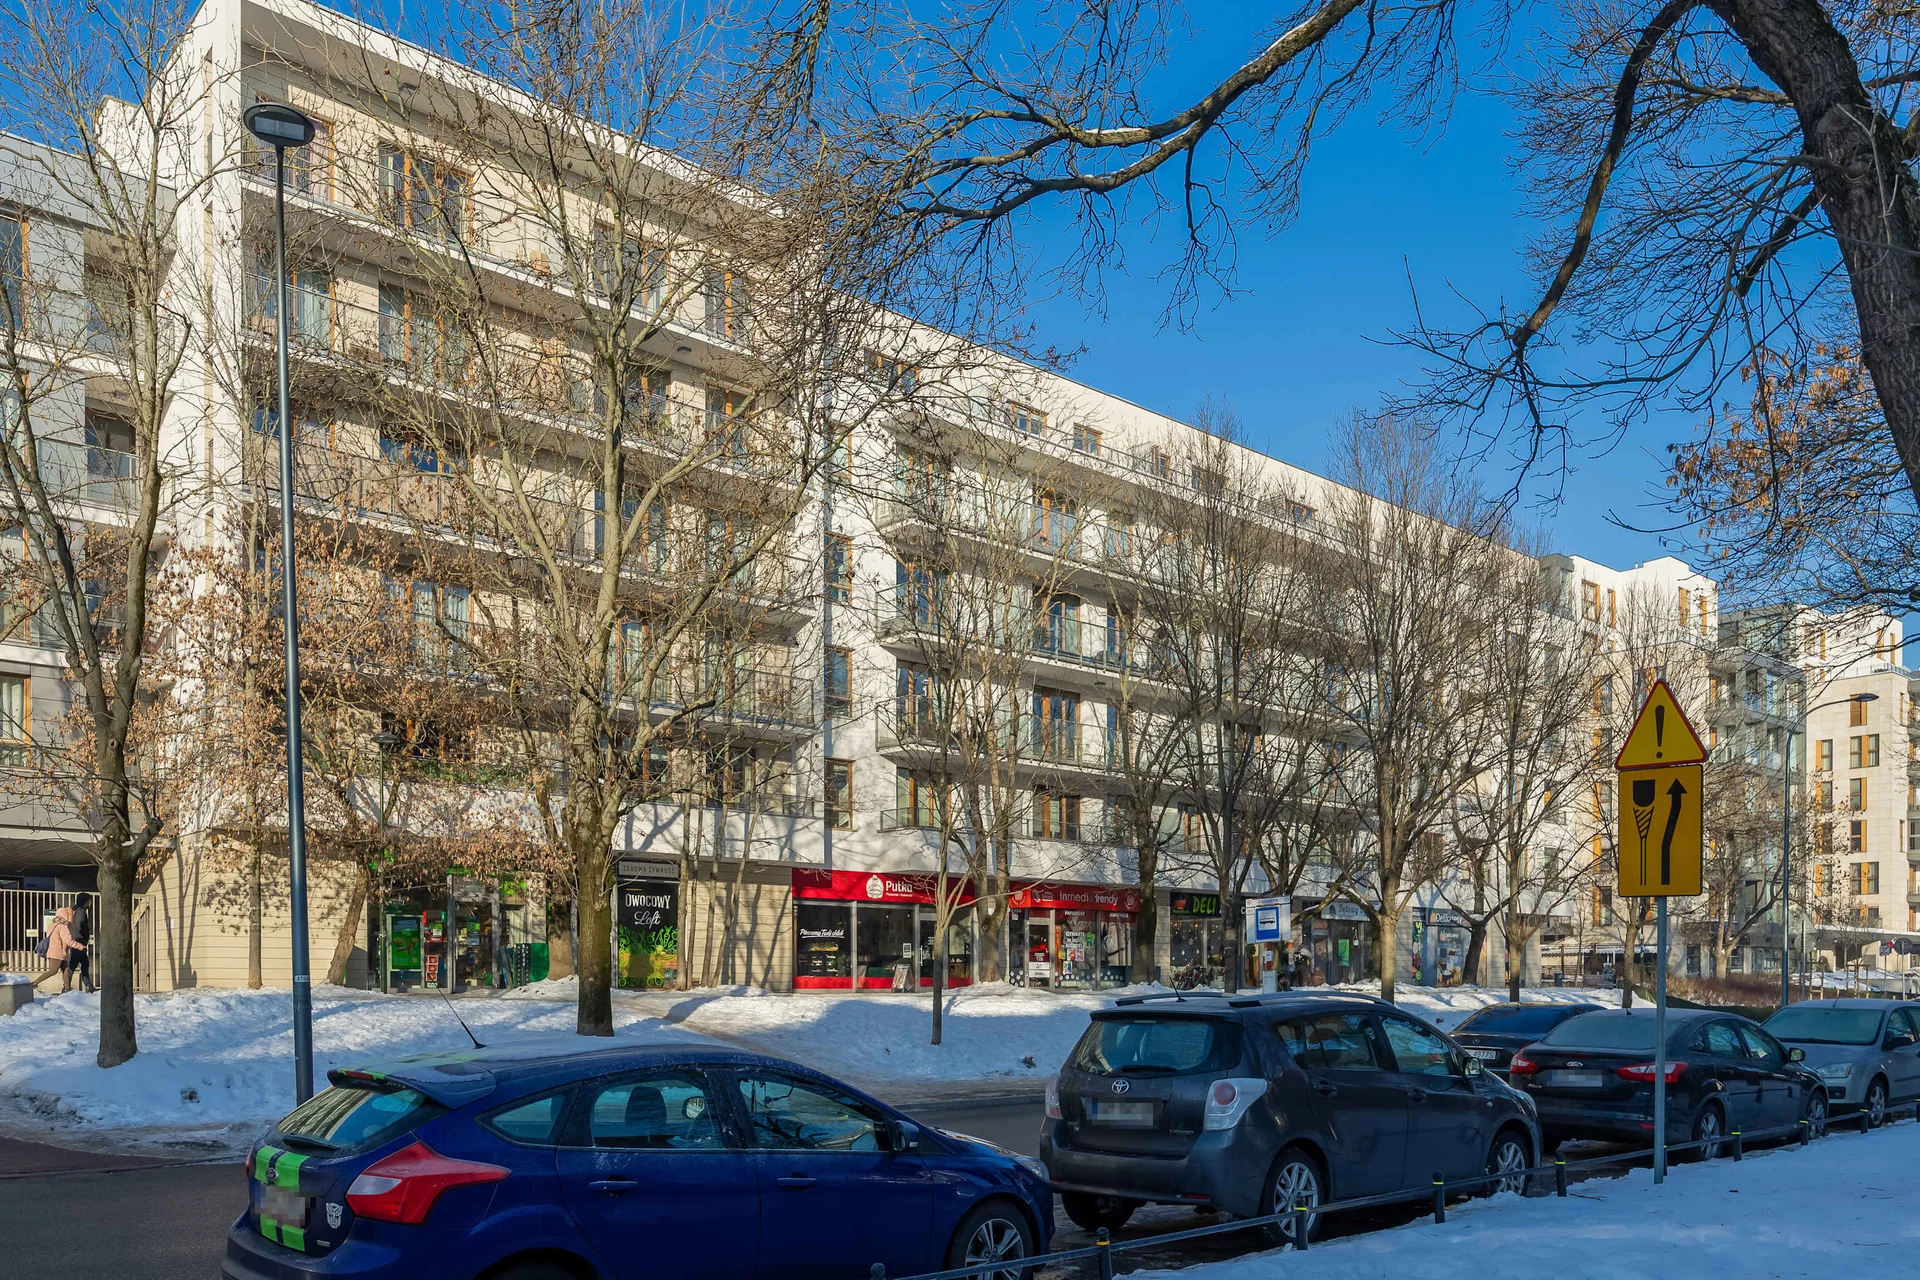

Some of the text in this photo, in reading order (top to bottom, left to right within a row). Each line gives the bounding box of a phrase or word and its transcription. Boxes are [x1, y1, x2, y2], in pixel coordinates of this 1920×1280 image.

[885, 880, 913, 892] Putka
[625, 893, 671, 909] OWOCOWY
[1095, 894, 1119, 907] trendy
[1192, 896, 1217, 915] DELI
[634, 910, 661, 929] Loft
